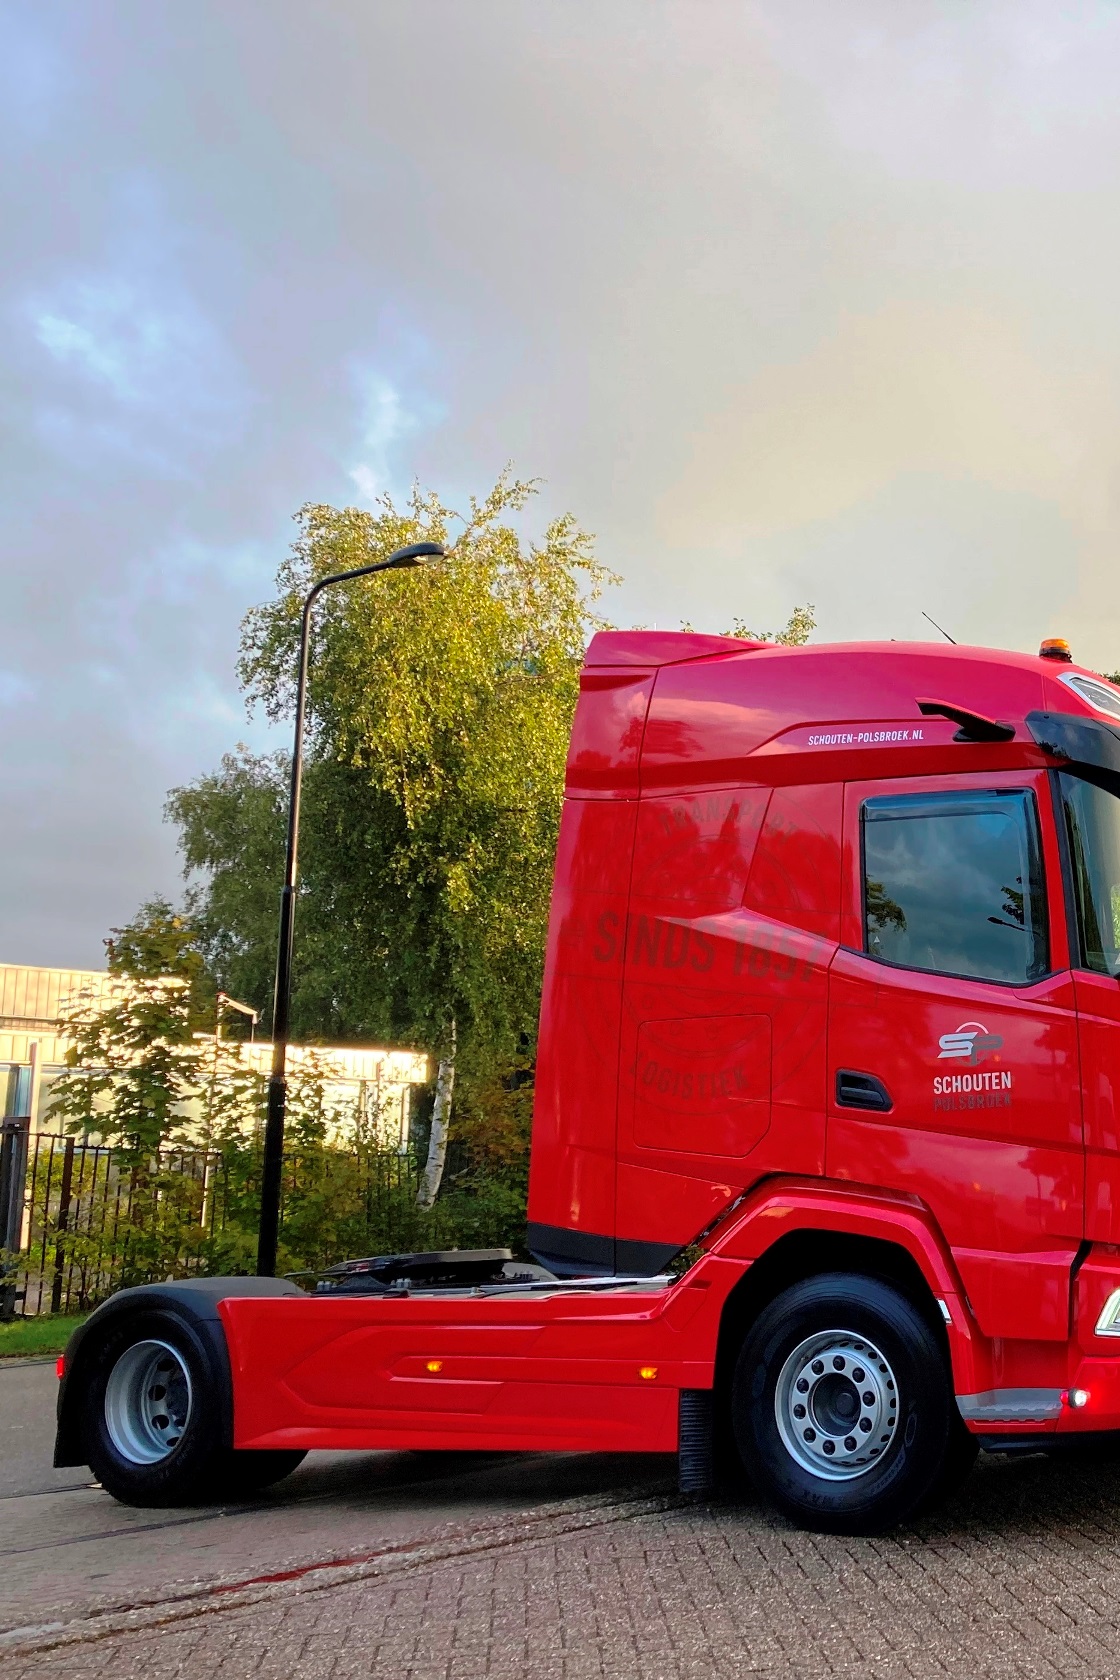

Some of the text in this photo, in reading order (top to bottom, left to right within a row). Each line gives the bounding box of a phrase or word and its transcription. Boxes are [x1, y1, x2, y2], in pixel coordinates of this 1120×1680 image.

[808, 729, 925, 746] SCHOUTEN-POLSBROEK.NL
[658, 798, 799, 841] TRANSPORT
[593, 910, 716, 973] SINDS
[629, 1051, 751, 1100] LOGISTIEK
[933, 1071, 1012, 1095] SCHOUTEN
[933, 1093, 1012, 1112] POLSBROEK
